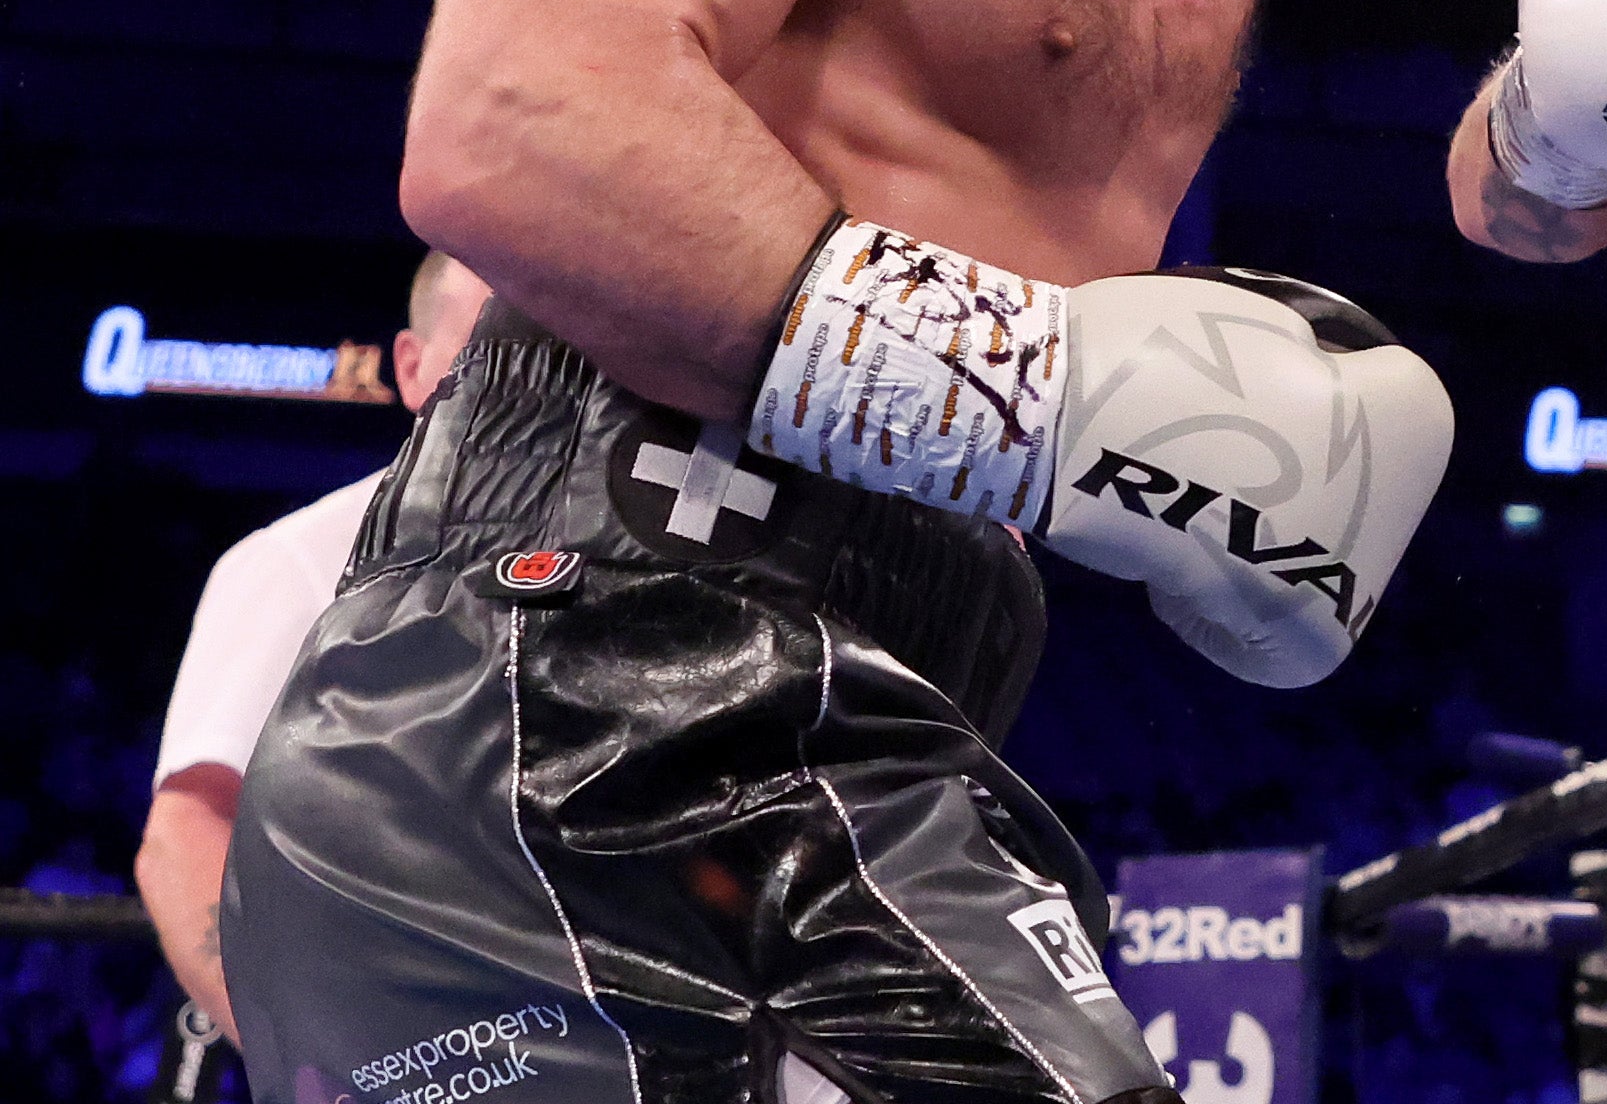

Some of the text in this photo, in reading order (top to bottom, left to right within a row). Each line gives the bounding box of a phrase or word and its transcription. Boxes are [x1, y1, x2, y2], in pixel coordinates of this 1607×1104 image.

[1071, 447, 1375, 642] RIVA
[1119, 901, 1303, 966] 32Red
[351, 1003, 569, 1093] essexproperty
